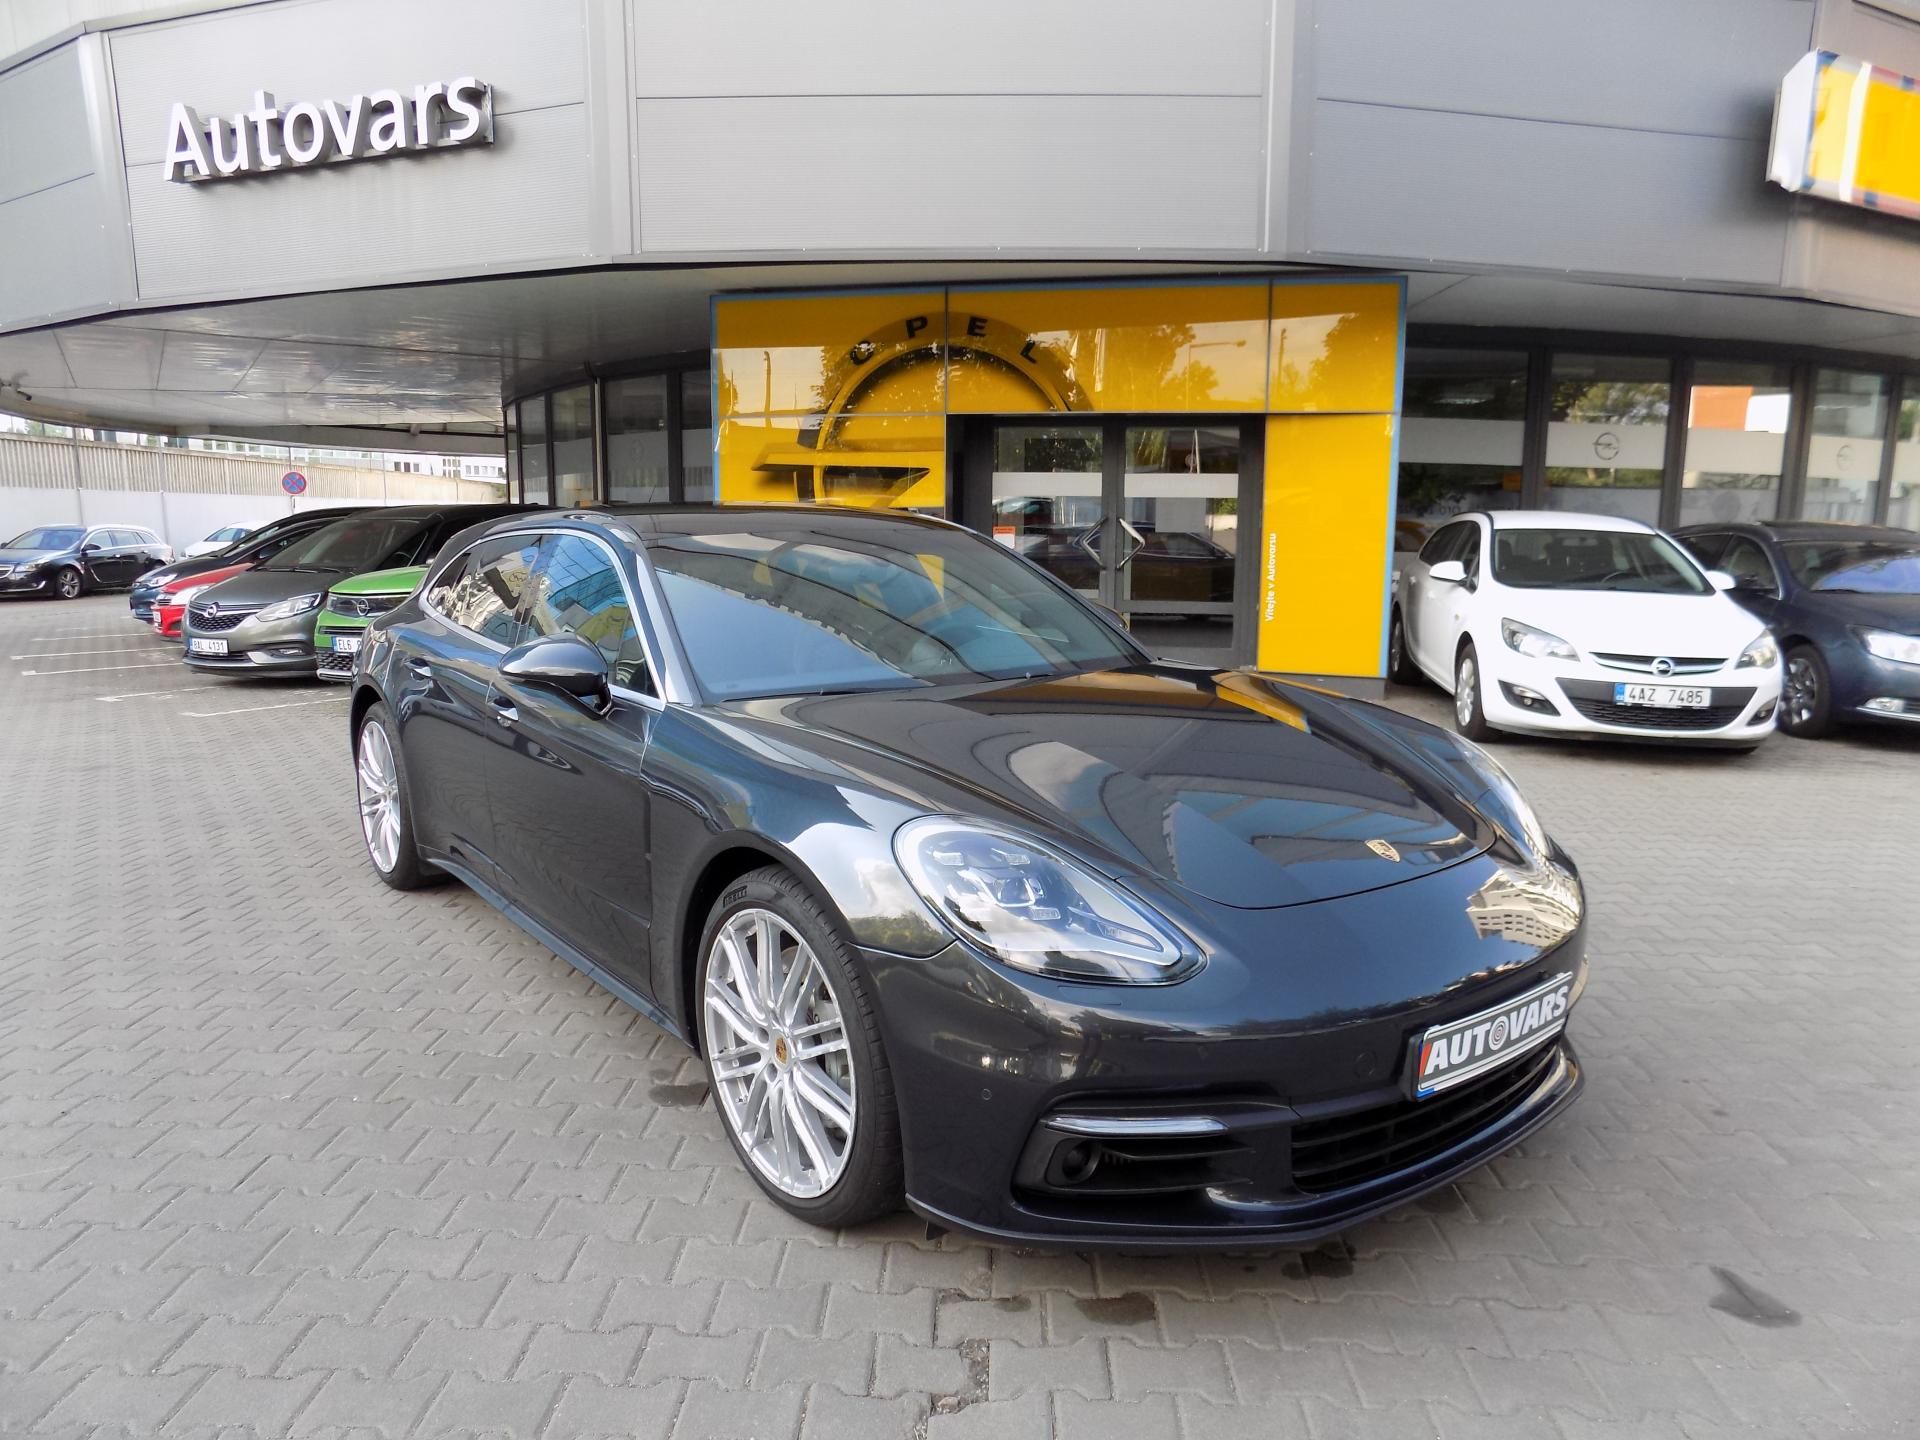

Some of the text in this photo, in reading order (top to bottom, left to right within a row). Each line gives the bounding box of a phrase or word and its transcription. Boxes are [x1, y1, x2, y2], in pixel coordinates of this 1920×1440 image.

[163, 76, 485, 182] Autovars
[849, 315, 1037, 365] OPEL
[1629, 687, 1703, 704] 4AZ 7485
[1424, 985, 1569, 1075] AUTOVARS
